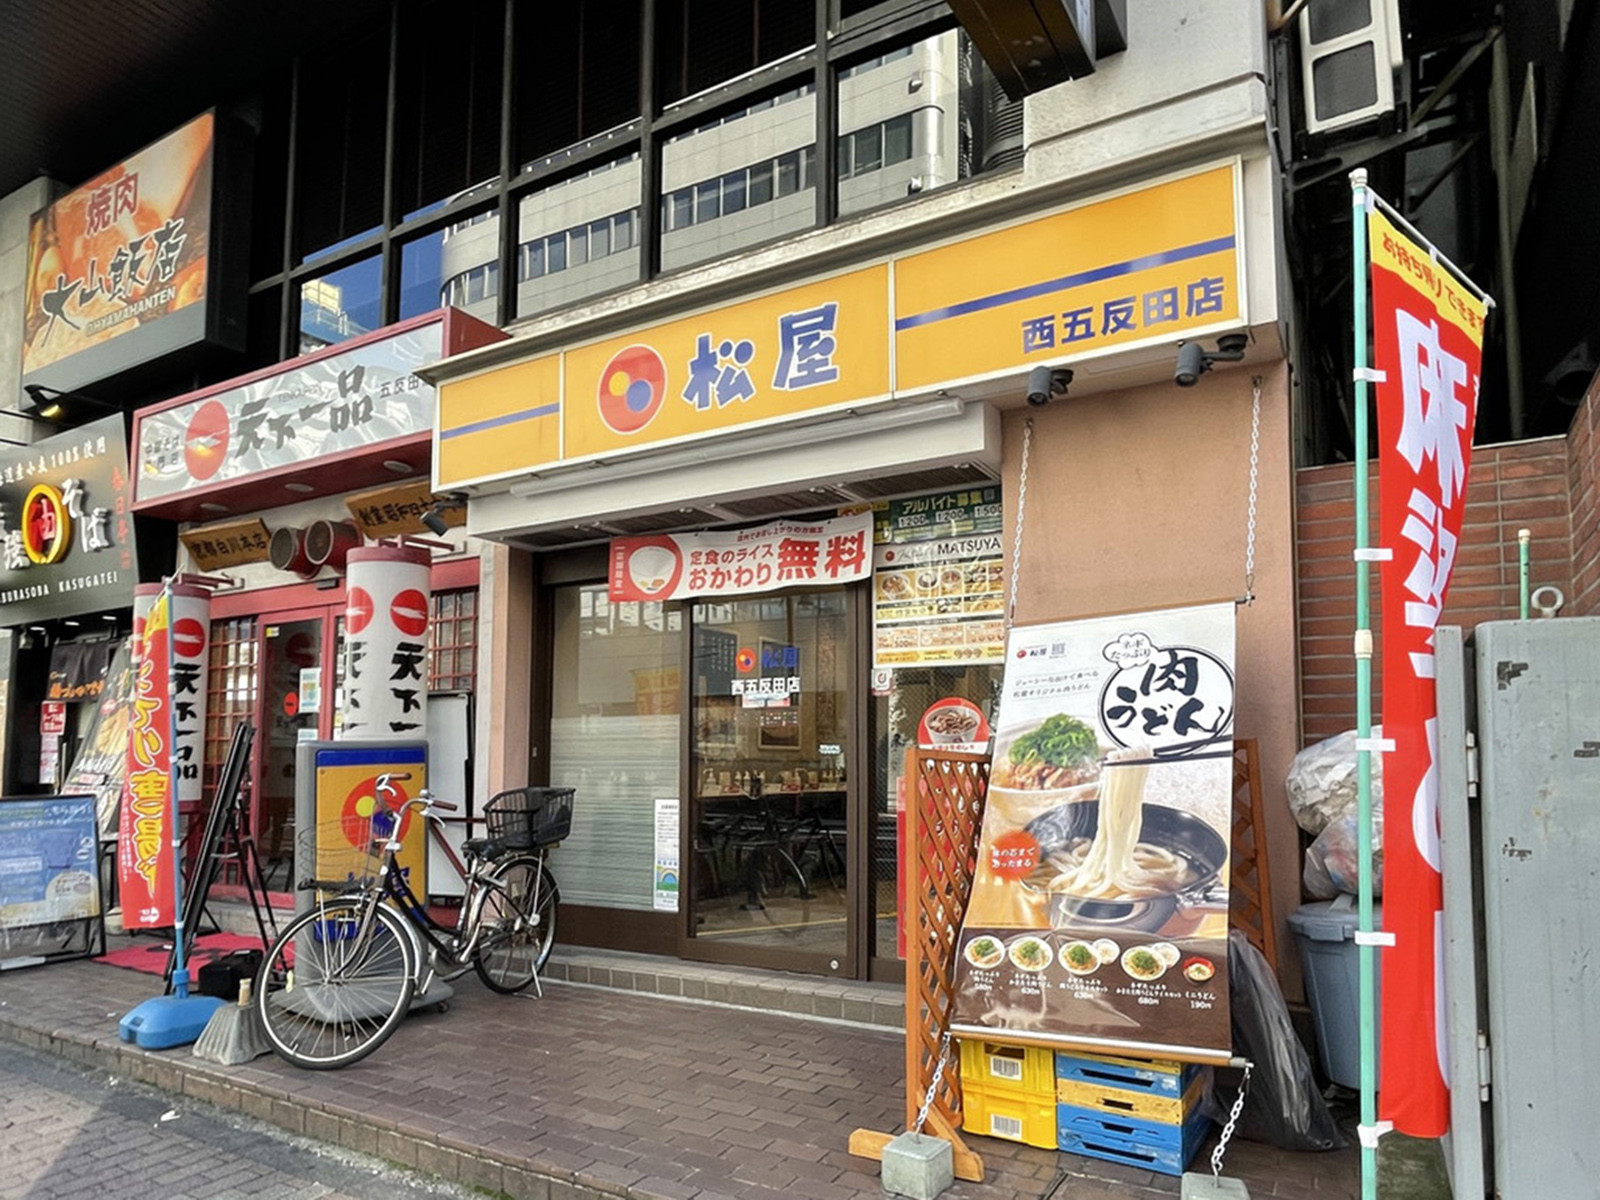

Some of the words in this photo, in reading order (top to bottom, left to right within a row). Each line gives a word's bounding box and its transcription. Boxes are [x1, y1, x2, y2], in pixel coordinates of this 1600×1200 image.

[85, 171, 139, 237] 焼肉
[1021, 275, 1225, 354] 西五反田店
[680, 300, 841, 410] 松屋
[379, 376, 429, 399] 五反田
[236, 364, 374, 459] 天下一品
[690, 543, 775, 566] 定食のライス
[776, 530, 867, 582] 無料
[937, 537, 1001, 555] MATSUYA
[58, 571, 118, 593] KASUGATEI
[688, 562, 772, 591] おかわり
[762, 646, 798, 669] 松屋
[1110, 647, 1151, 660] たっぷり
[731, 676, 801, 696] 西五反田店
[1140, 649, 1200, 697] 肉
[1106, 686, 1226, 737] うどん
